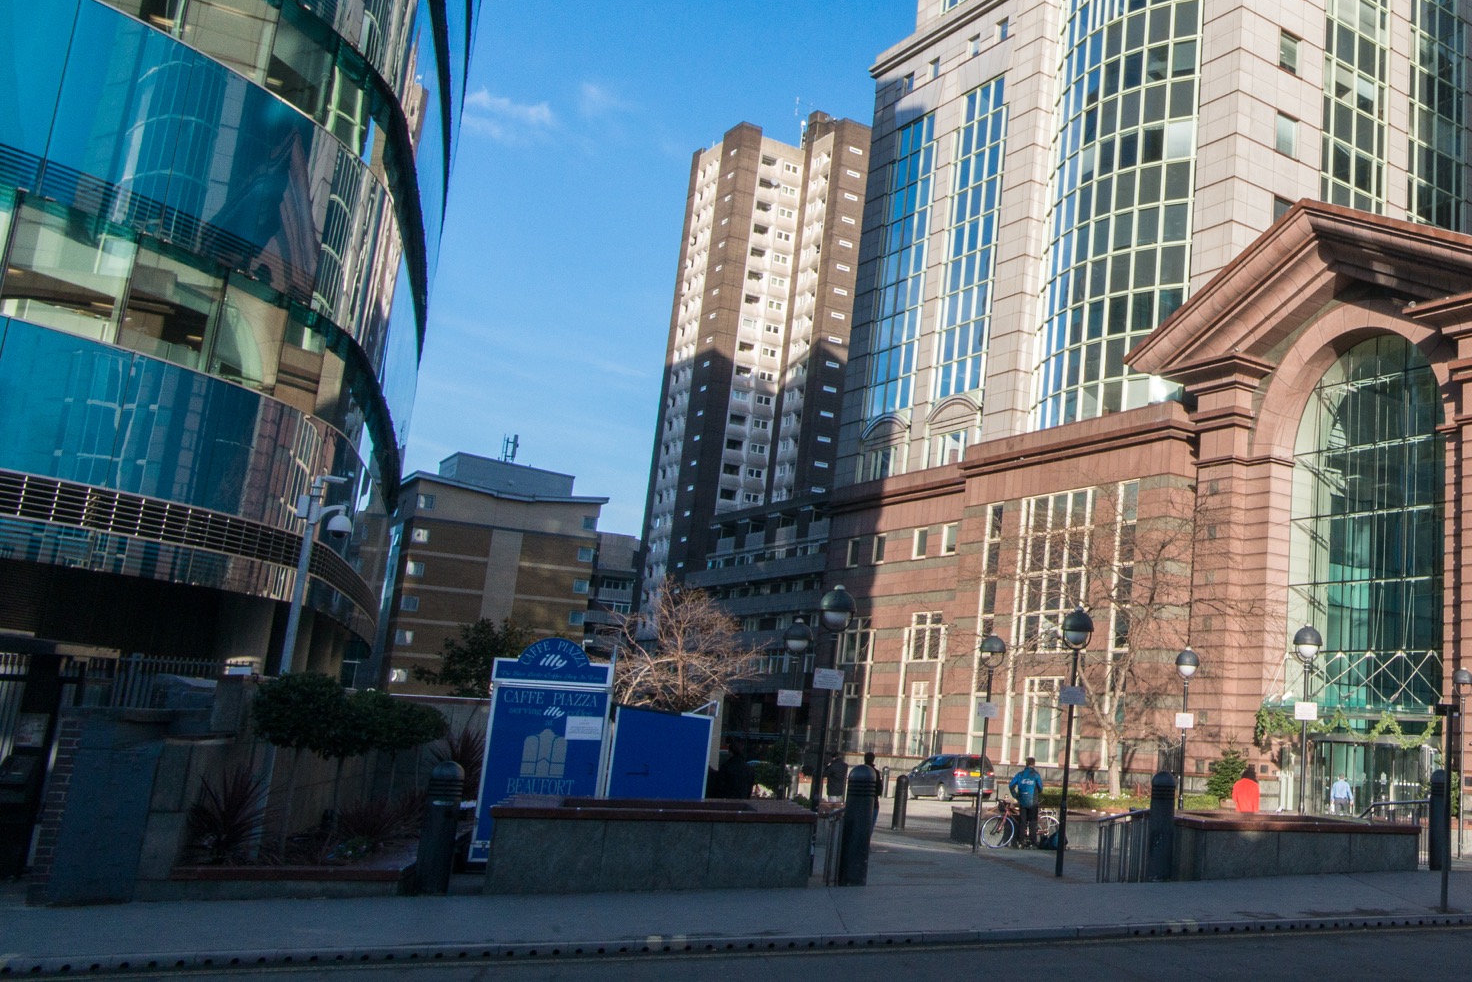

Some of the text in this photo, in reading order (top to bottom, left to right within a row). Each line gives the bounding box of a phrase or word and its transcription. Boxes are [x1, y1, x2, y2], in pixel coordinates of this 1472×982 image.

[521, 641, 587, 668] CAFFE PIAZZA
[540, 654, 567, 670] illy
[504, 690, 598, 707] CAFFE PIAZZA
[508, 706, 593, 719] serving illy coffee
[506, 778, 575, 795] BEAUFORT
